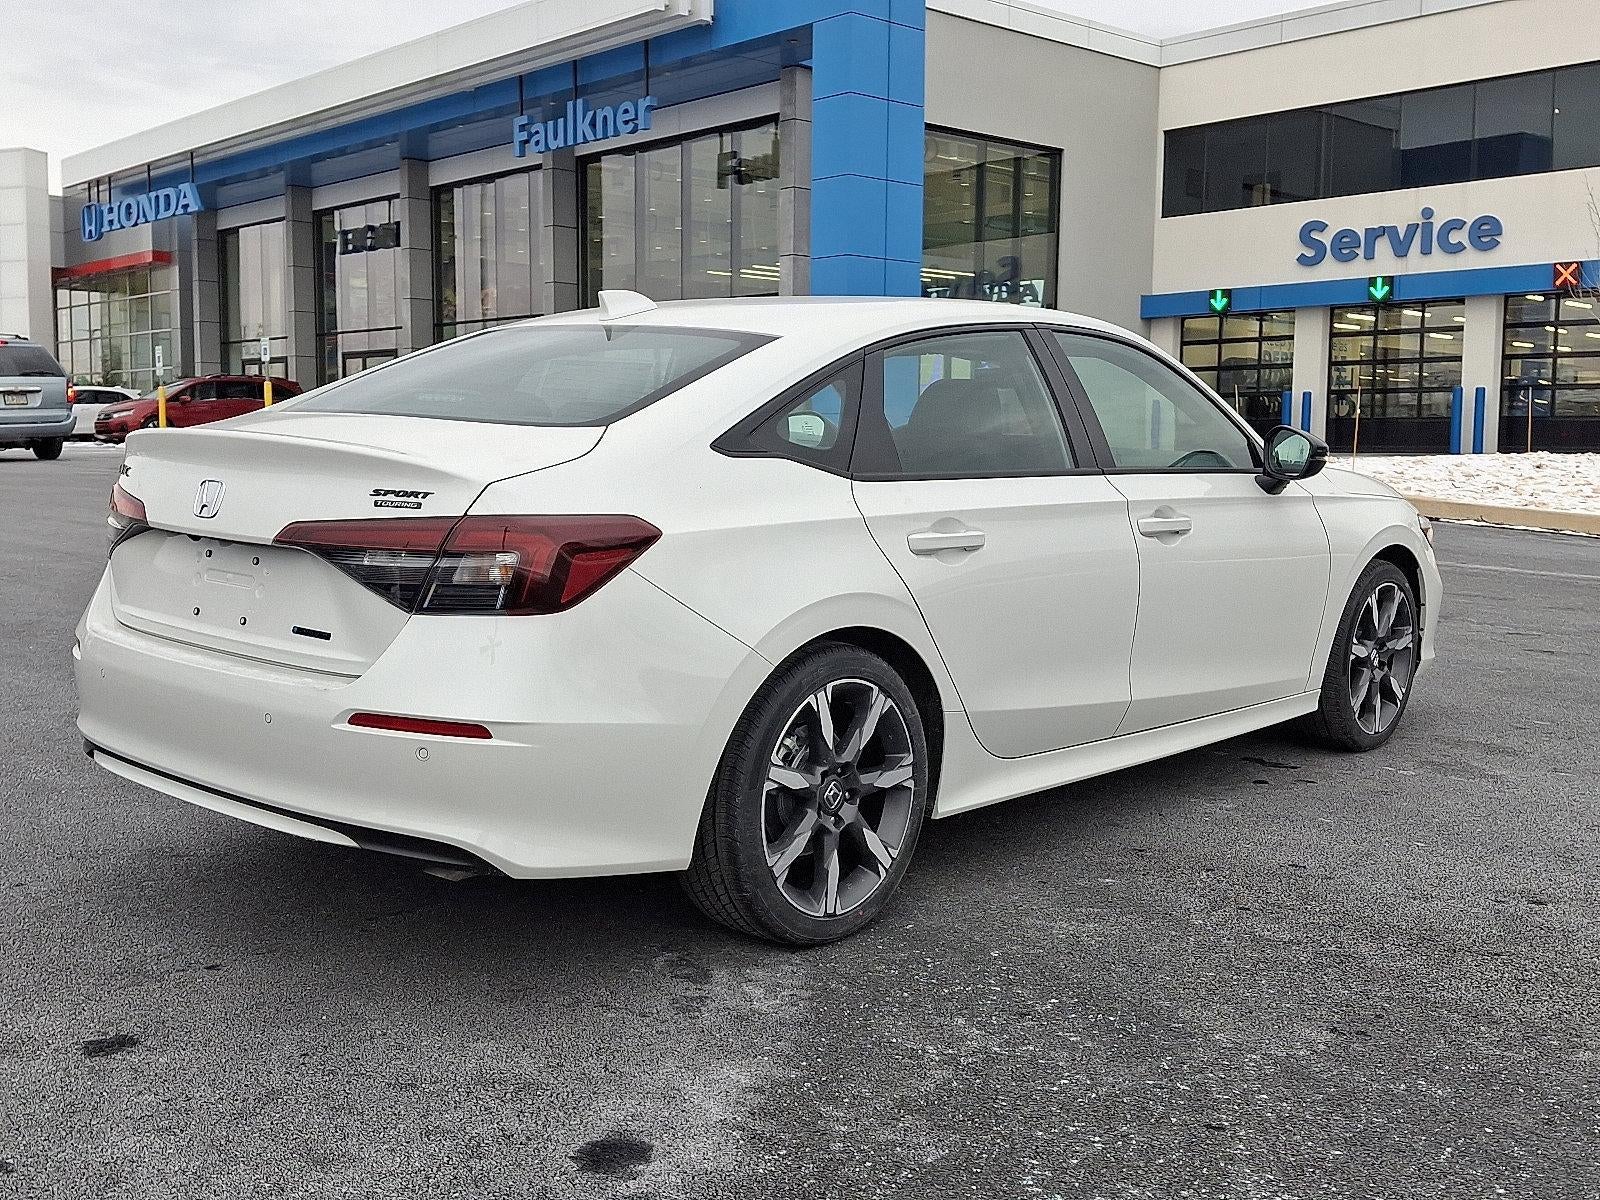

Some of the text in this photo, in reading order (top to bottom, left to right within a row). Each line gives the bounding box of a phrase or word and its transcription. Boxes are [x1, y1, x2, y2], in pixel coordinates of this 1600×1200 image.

[513, 95, 657, 157] Faulkner
[101, 182, 203, 232] HONDA
[1296, 207, 1503, 266] Service
[369, 488, 435, 499] SPORT
[376, 500, 418, 508] TOURING
